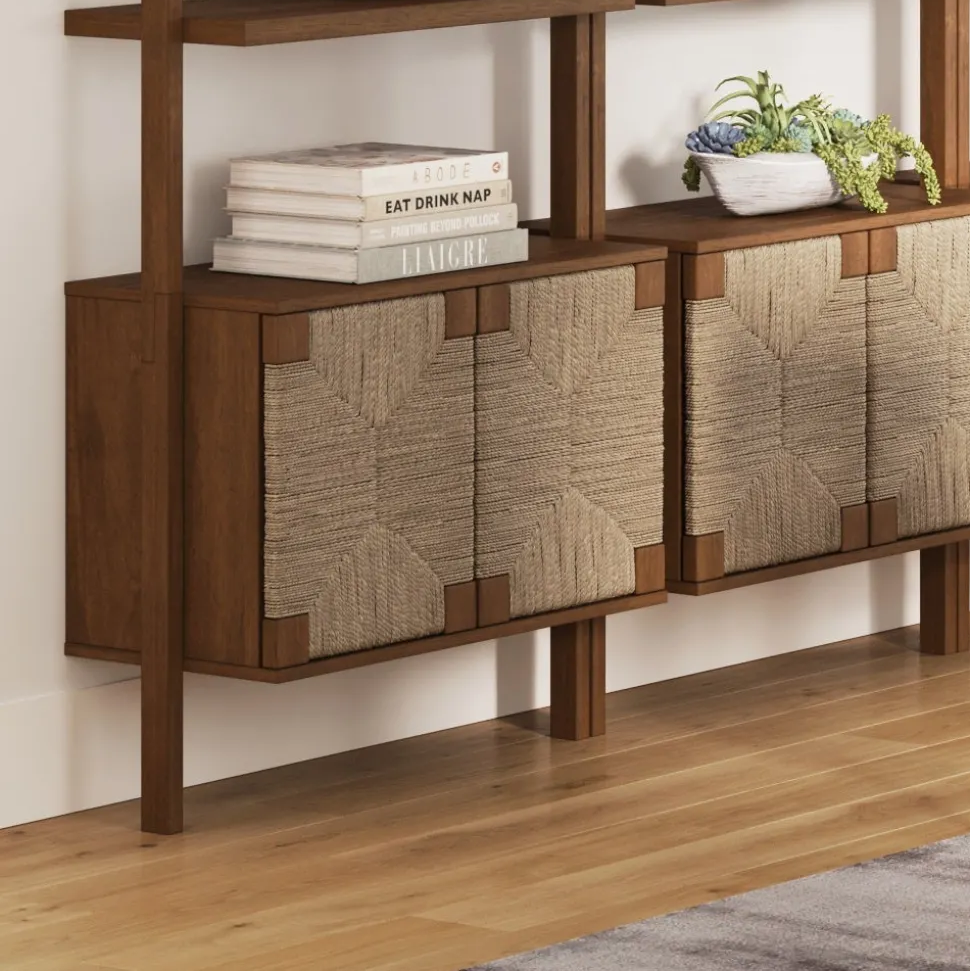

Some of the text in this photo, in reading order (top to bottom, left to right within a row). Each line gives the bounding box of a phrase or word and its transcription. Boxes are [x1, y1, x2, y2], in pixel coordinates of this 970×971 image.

[412, 162, 471, 184] ABODE
[385, 188, 491, 214] EAT DRINK NAP
[430, 216, 461, 234] BEYOND
[463, 212, 500, 232] POLLOCK
[402, 237, 488, 275] LIAIGRE
